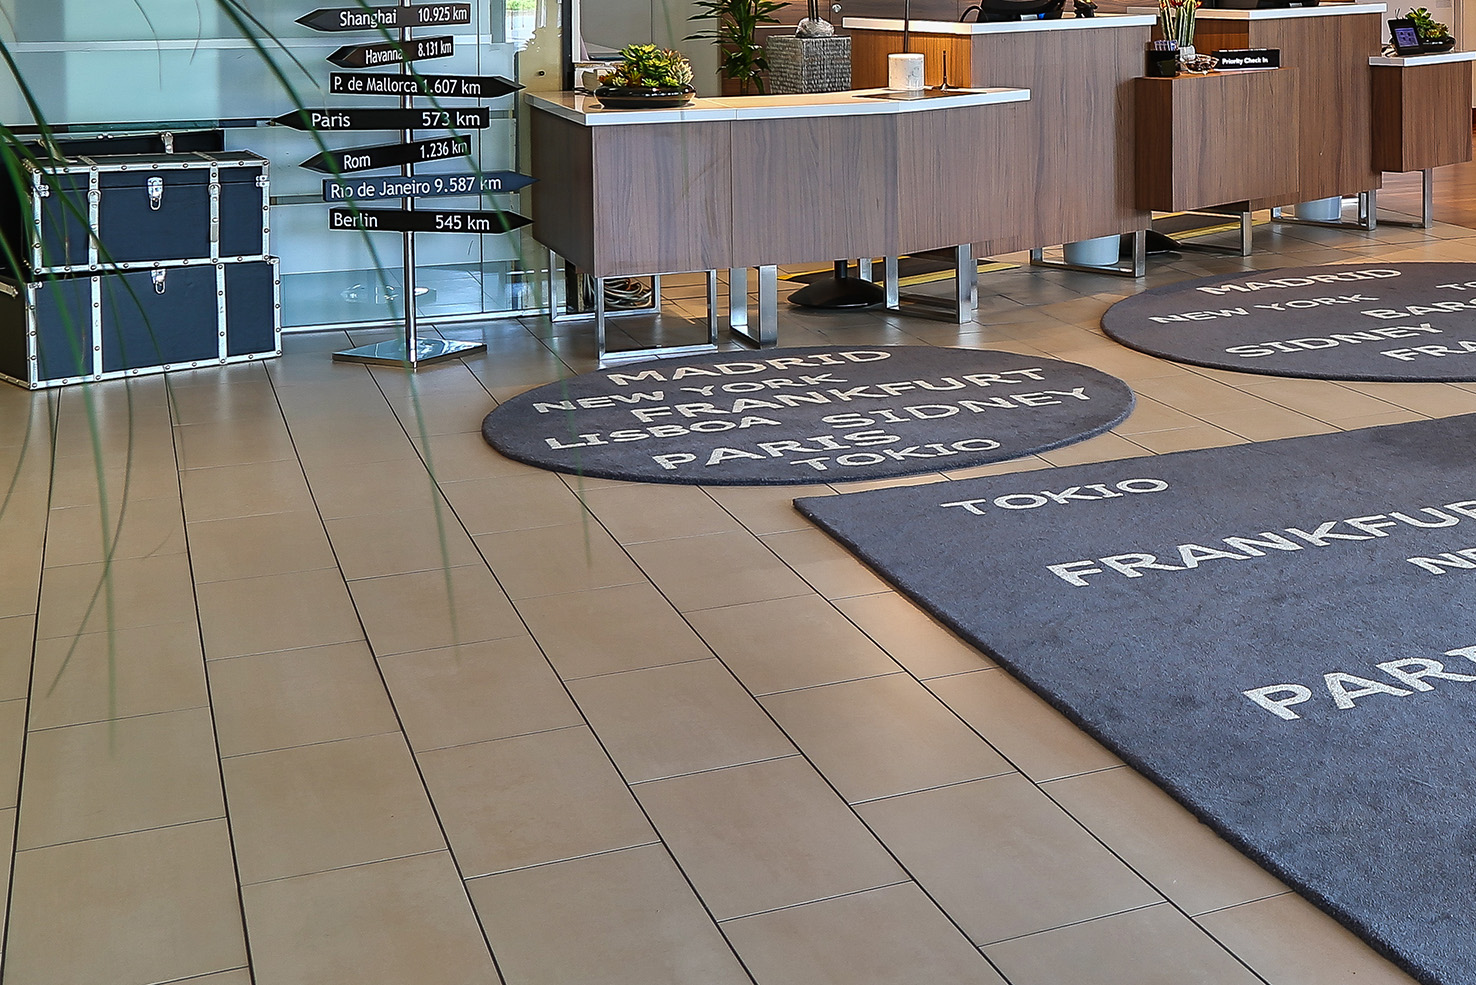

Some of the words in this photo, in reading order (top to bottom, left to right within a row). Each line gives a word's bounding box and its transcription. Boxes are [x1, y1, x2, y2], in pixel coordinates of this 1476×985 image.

[339, 9, 397, 28] Shanghai
[418, 7, 450, 22] 10.925
[453, 6, 467, 21] km
[365, 49, 403, 65] Havanna
[417, 41, 439, 56] 8.131
[440, 41, 452, 54] km
[334, 77, 344, 91] P.
[347, 77, 363, 91] de
[366, 78, 418, 93] Mallorca
[422, 79, 457, 94] 1.607
[461, 79, 480, 95] km
[311, 112, 351, 128] Paris
[422, 112, 450, 126] 573
[456, 111, 480, 126] km
[343, 154, 371, 169] Rom
[420, 143, 449, 159] 1.236
[451, 141, 467, 156] km
[331, 183, 353, 199] Rio
[357, 182, 375, 197] de
[379, 180, 430, 196] Janeiro
[434, 177, 475, 193] 9.587
[480, 176, 502, 191] km
[334, 212, 378, 228] Berlin
[435, 216, 462, 230] 545
[467, 215, 490, 231] km
[1196, 269, 1402, 295] MADRID
[1148, 307, 1250, 324] NEW
[1254, 293, 1380, 311] YORK
[1225, 322, 1443, 357] SIDNEY
[606, 350, 892, 386] MADRID
[532, 390, 665, 413] NEW
[680, 373, 848, 397] YORK
[630, 368, 1046, 423] FRANKFURT
[544, 416, 782, 450] LISBOA
[821, 386, 1091, 429] SIDNEY
[651, 429, 901, 470] PARIS
[789, 438, 1001, 472] TOKIO
[940, 477, 1170, 516] TOKIO
